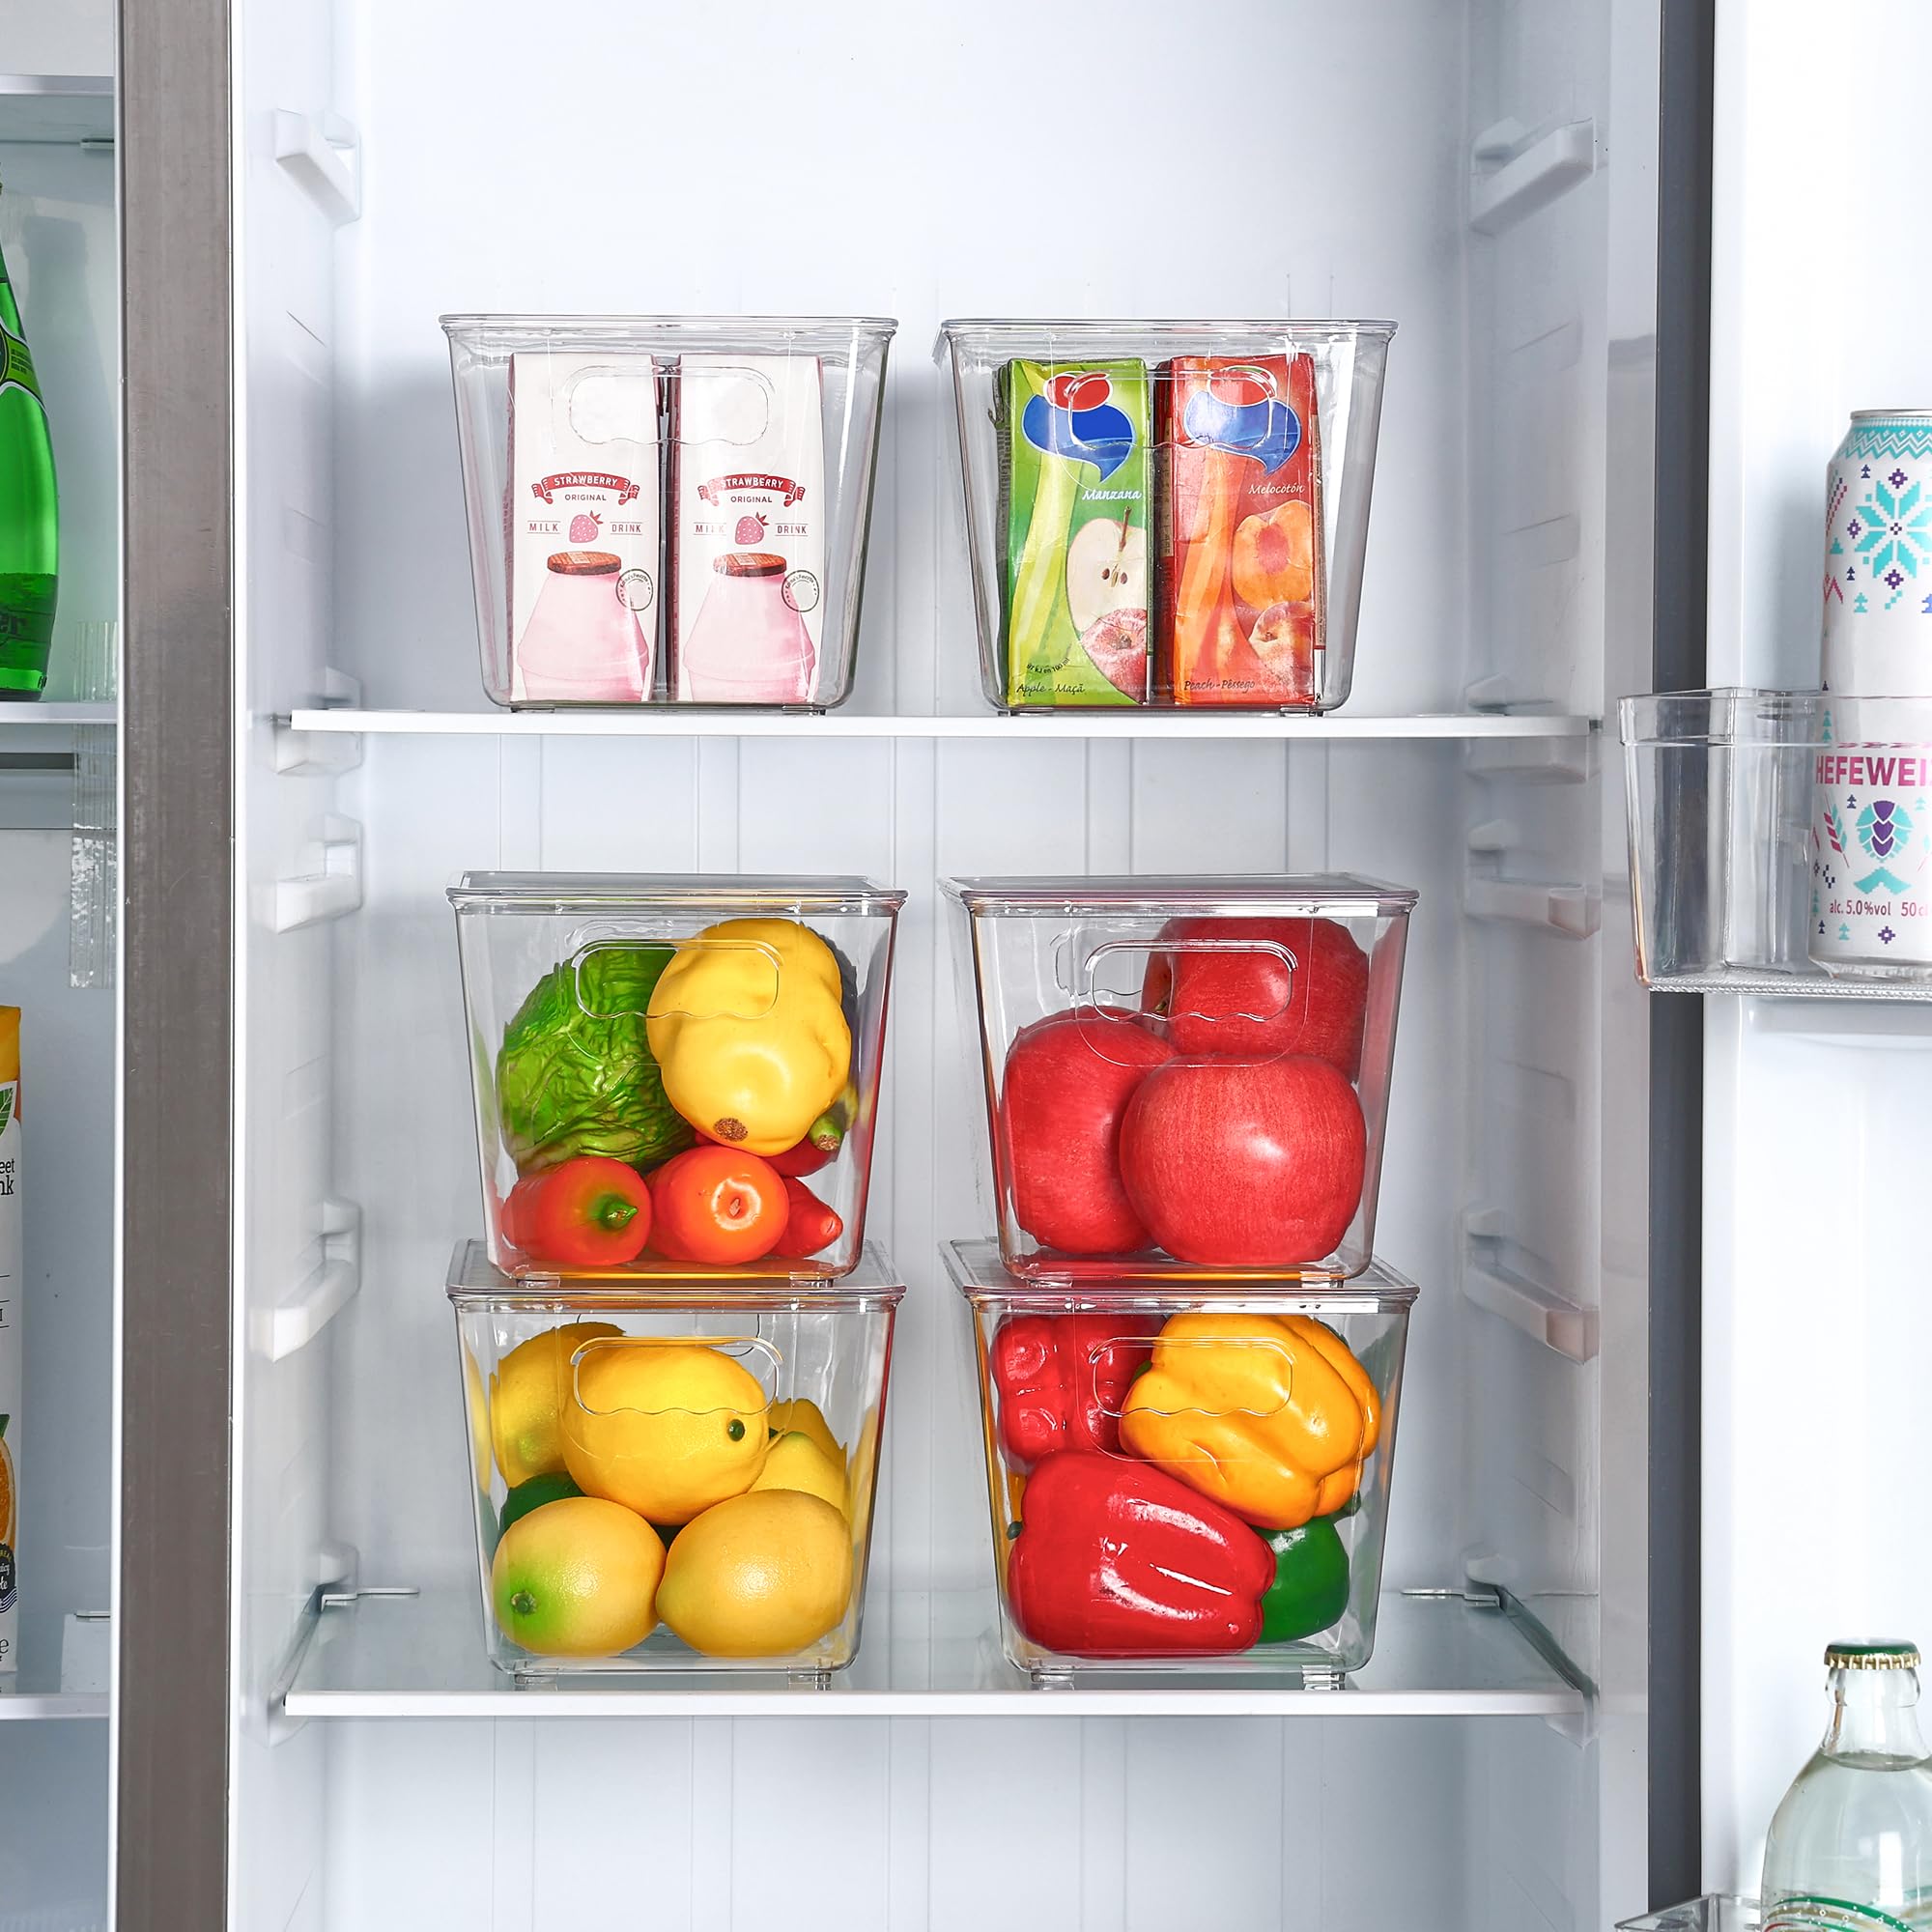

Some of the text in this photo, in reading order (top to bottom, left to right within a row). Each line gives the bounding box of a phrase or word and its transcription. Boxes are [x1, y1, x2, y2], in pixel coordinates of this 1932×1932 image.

[554, 474, 618, 487] STRAWBERRY
[1082, 489, 1143, 500] Manzana
[1248, 482, 1305, 495] Melocotón
[528, 523, 641, 532] MILK DRINK
[777, 525, 807, 534] DRINK
[1016, 682, 1046, 696] Apple
[1054, 683, 1086, 695] Maçã
[1183, 678, 1215, 690] Peach
[1221, 679, 1256, 694] Pêssego
[1815, 755, 1932, 786] HEFEWEI
[1830, 899, 1844, 914] alc.
